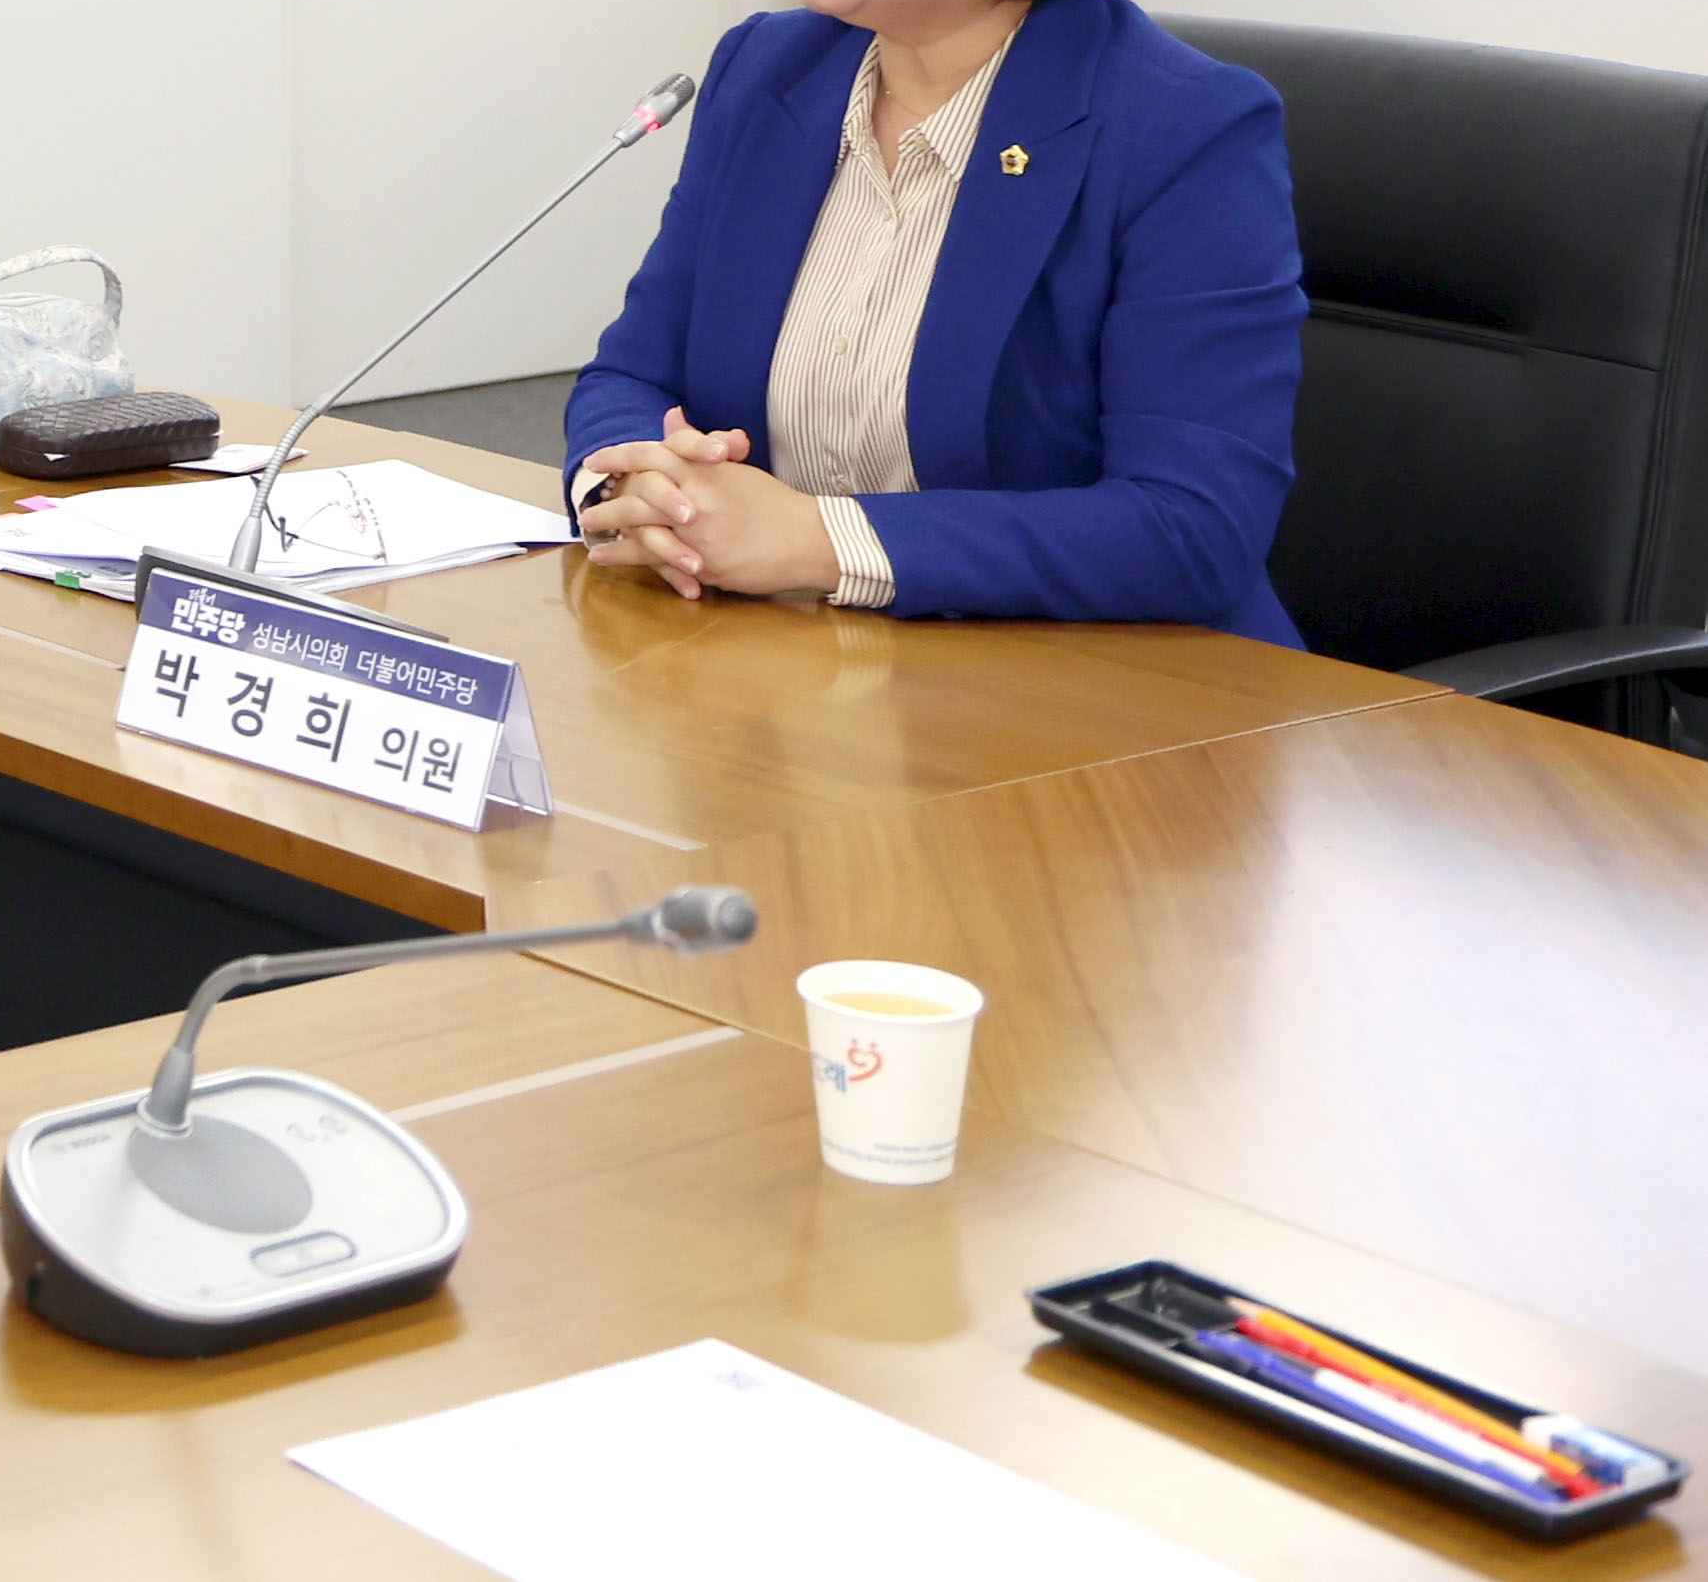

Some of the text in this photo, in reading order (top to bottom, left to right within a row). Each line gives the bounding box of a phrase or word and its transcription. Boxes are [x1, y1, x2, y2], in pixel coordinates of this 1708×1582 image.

[170, 596, 479, 707] 민주당 성남시의회 더불어민주당
[373, 725, 464, 794] 의원
